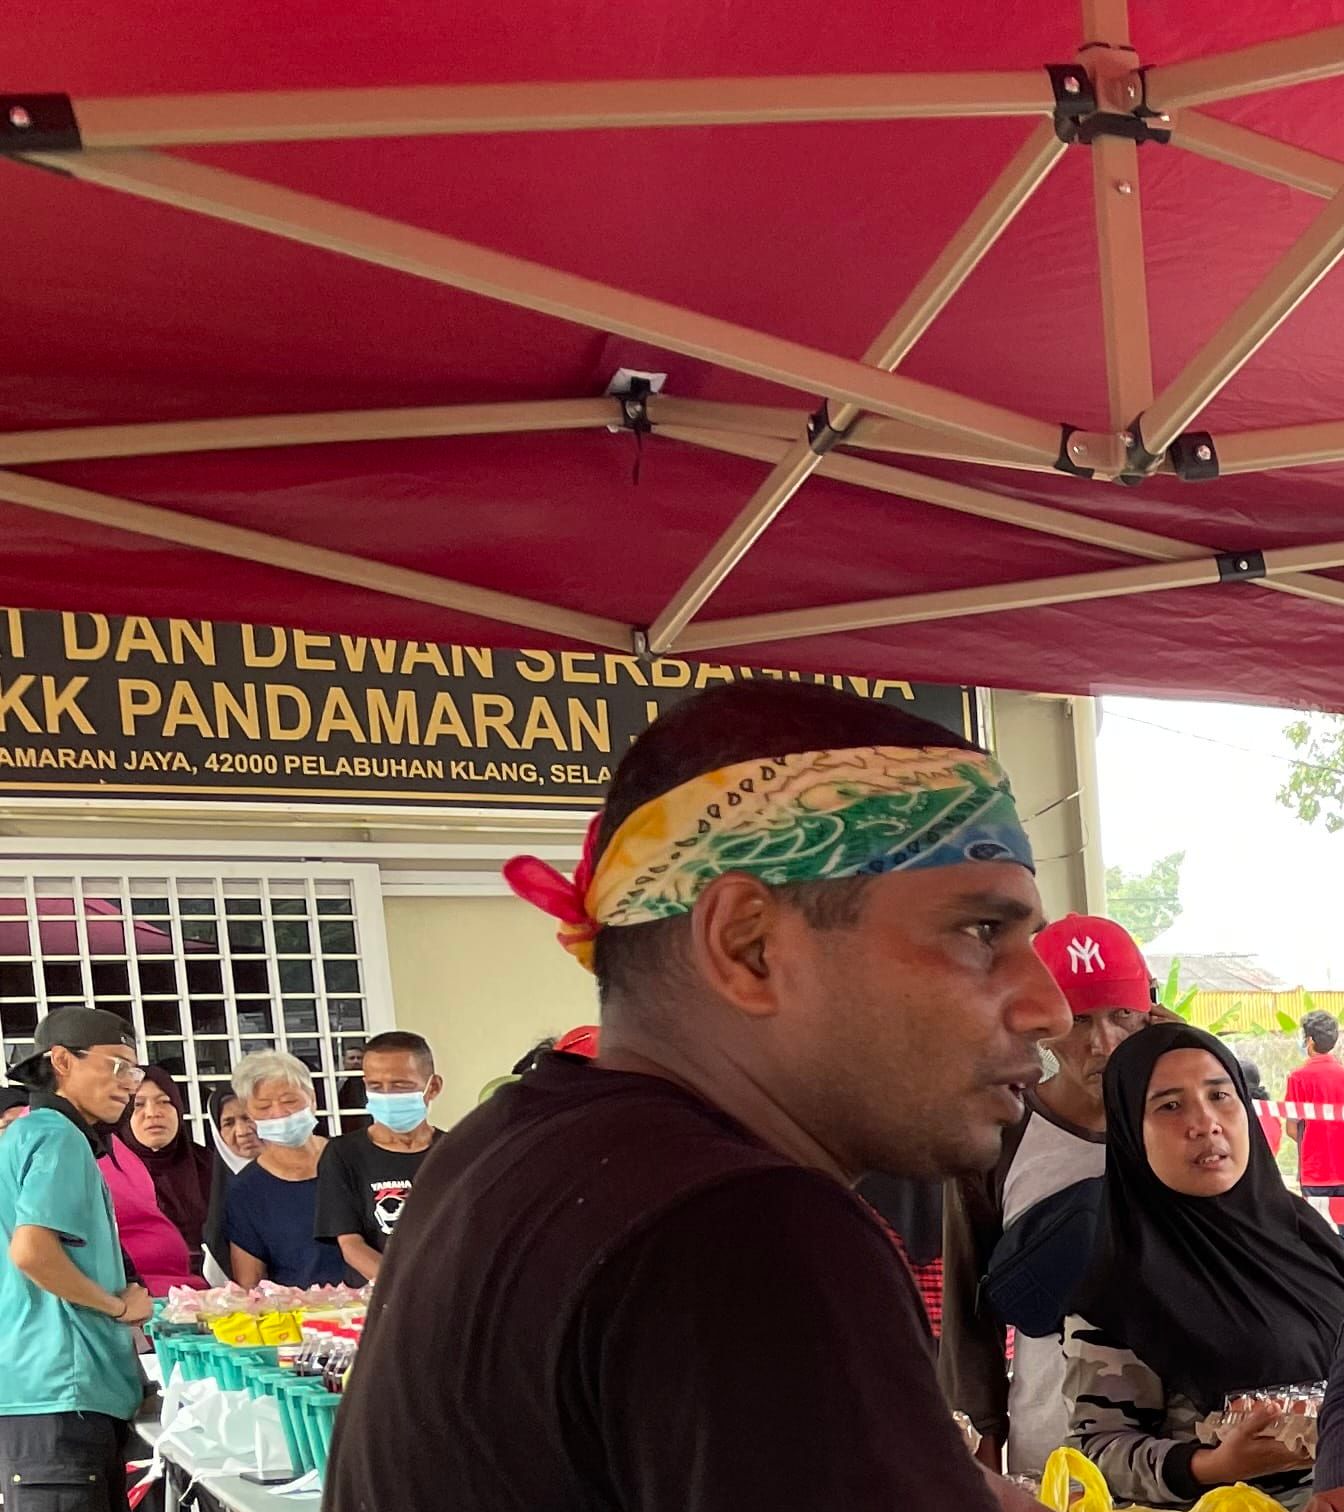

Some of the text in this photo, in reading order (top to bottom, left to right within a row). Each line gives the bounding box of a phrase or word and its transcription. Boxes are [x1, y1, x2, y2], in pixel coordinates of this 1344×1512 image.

[61, 611, 216, 667] DAN
[241, 623, 495, 679] DEWAN
[118, 678, 611, 753] PANDAMARAN
[123, 751, 198, 776] JAYA,
[205, 752, 278, 774] 42000
[285, 755, 443, 779] PELABUHAN
[450, 761, 545, 786] KLANG,
[550, 764, 613, 785] SELA
[370, 1179, 413, 1192] YAMAHA
